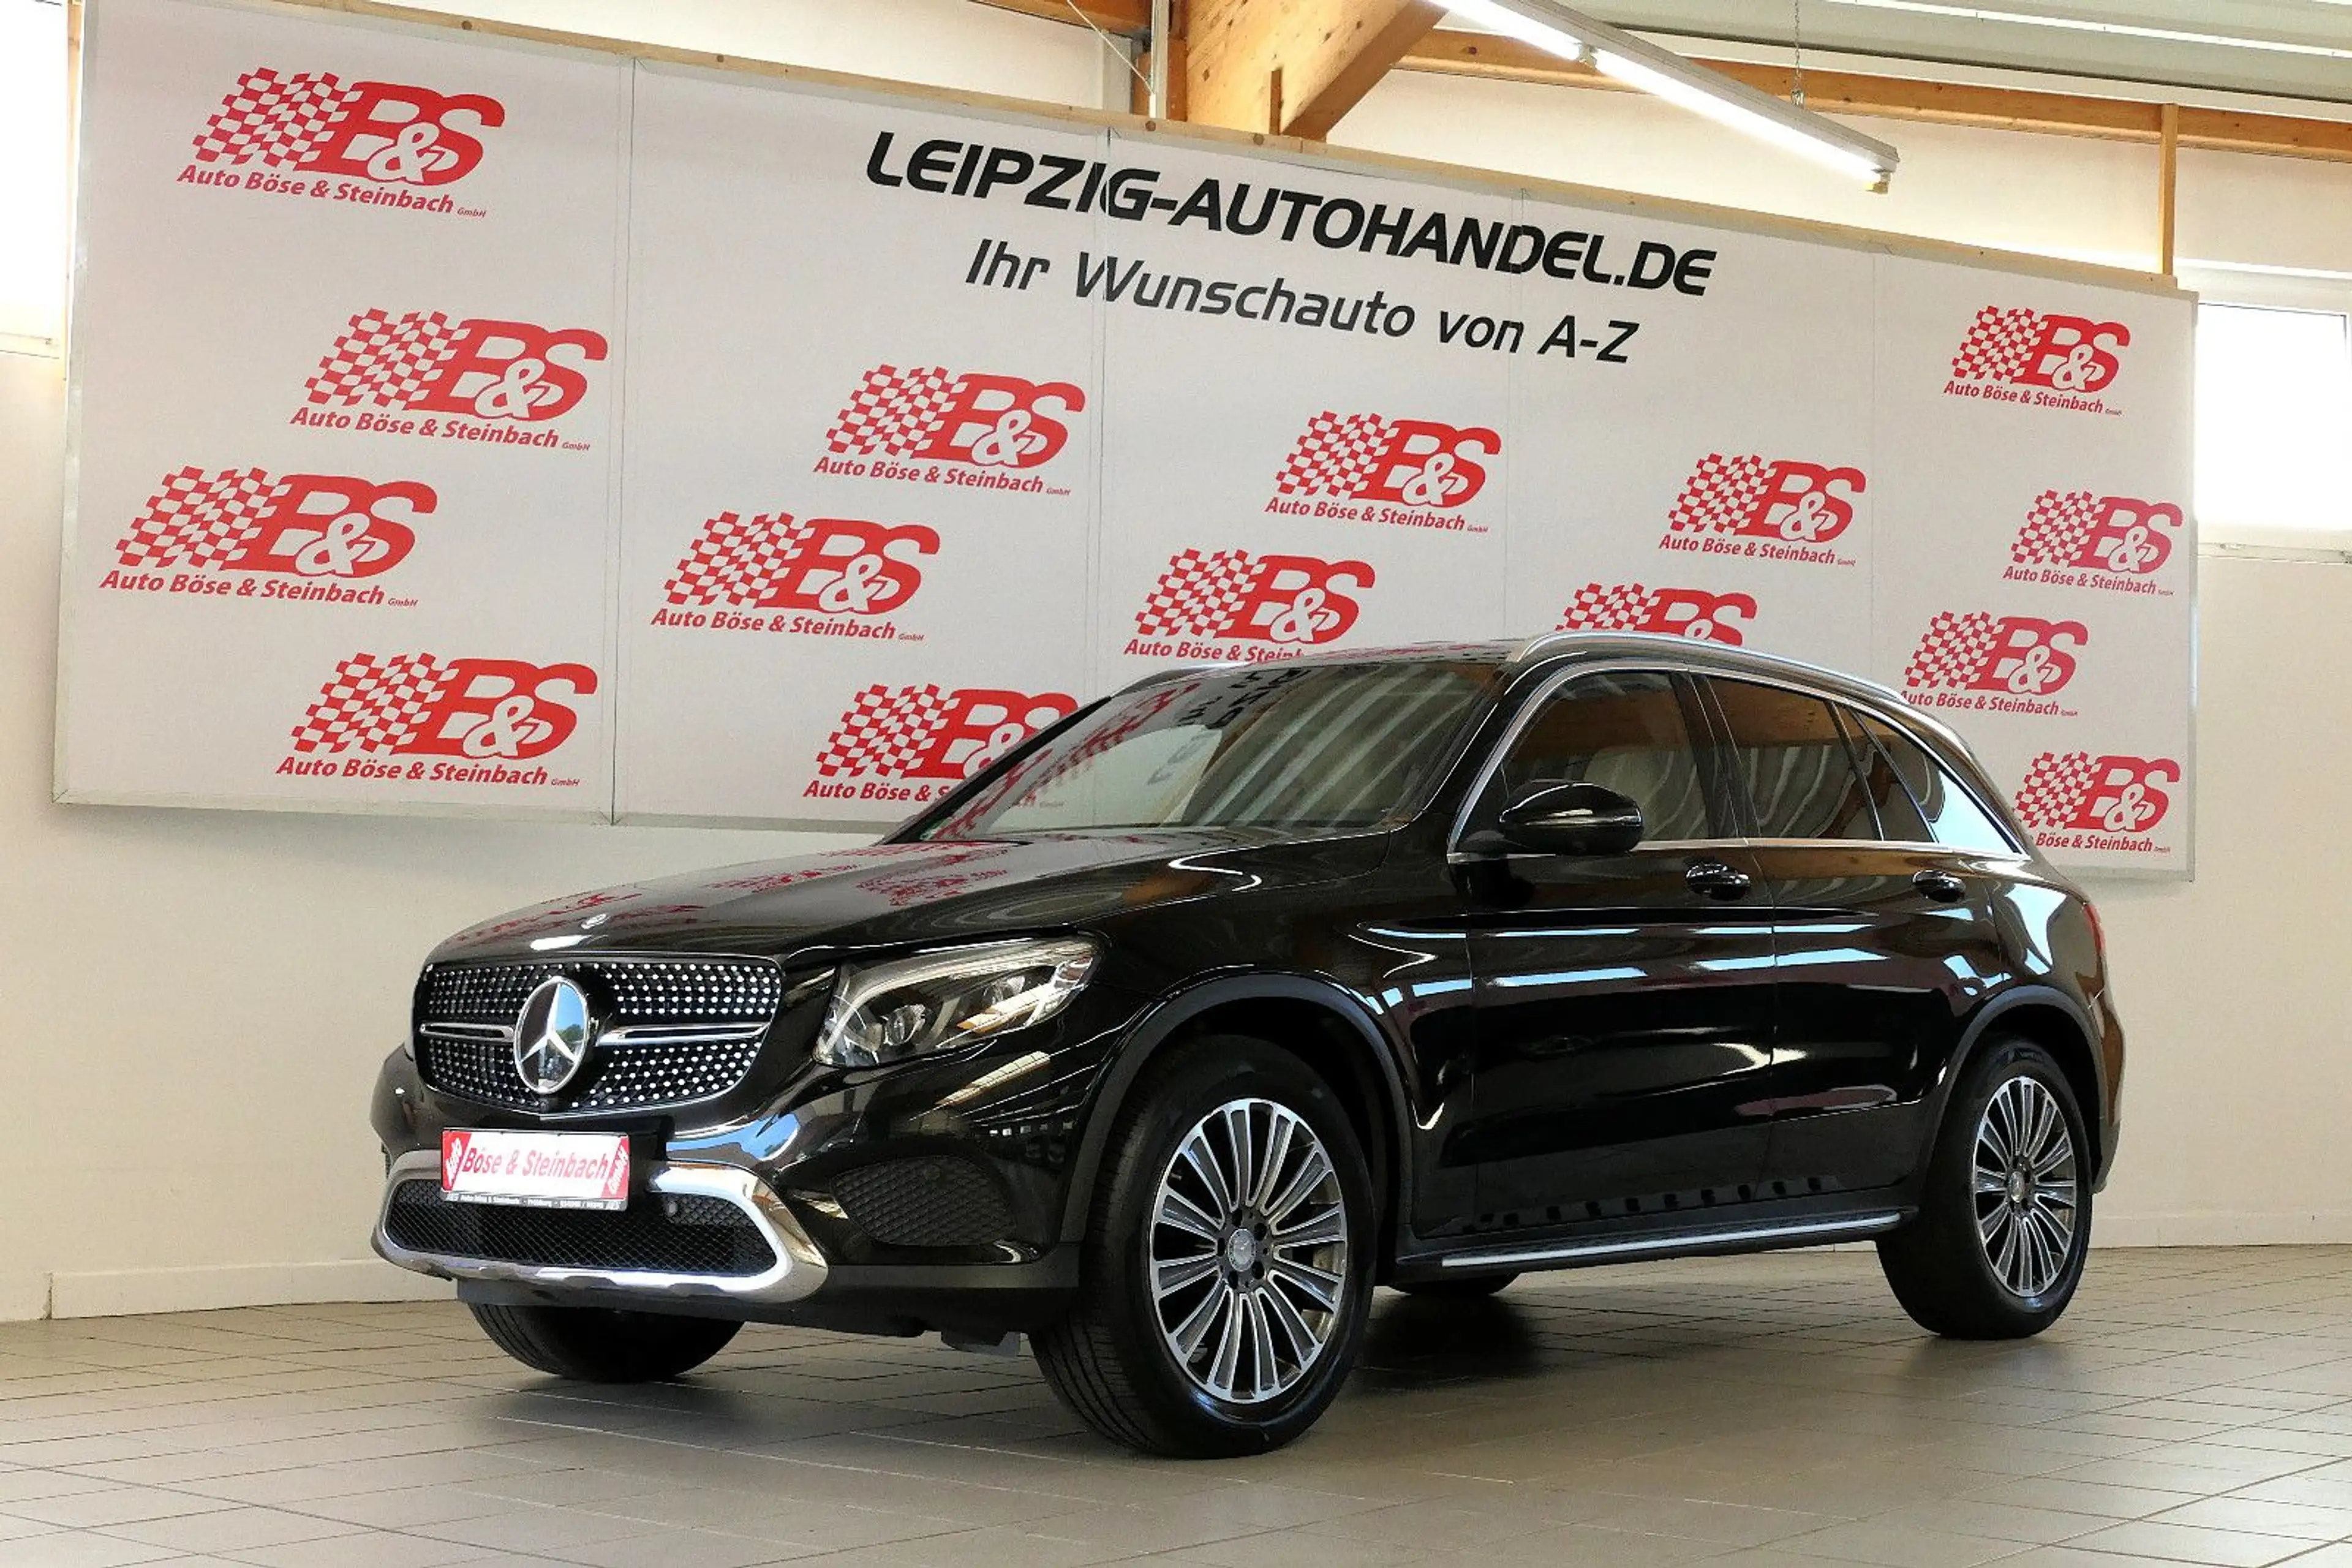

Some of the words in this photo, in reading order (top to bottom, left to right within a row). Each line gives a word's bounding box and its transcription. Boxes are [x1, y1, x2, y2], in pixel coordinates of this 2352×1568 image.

[176, 163, 240, 189] Auto
[244, 171, 306, 196] Böse
[310, 180, 330, 198] &
[333, 182, 454, 213] Steinbach
[457, 207, 486, 218] GmbH
[867, 131, 1717, 296] LEIPZIG-AUTOHANDEL.DE
[965, 239, 1049, 290] Ihr
[1074, 251, 1416, 337] Wunschauto
[1439, 311, 1524, 353] von
[1538, 314, 1638, 363] A-Z
[1943, 380, 1980, 397] Auto
[1983, 385, 2018, 402] Böse
[2020, 390, 2031, 404] &
[2033, 392, 2104, 413] Steinbach
[290, 407, 352, 429] Auto
[355, 411, 415, 435] Böse
[418, 418, 437, 437] &
[442, 419, 559, 448] Steinbach
[562, 441, 590, 451] GmbH
[813, 456, 865, 476] Auto
[870, 460, 920, 483] Böse
[924, 467, 940, 483] &
[944, 468, 1044, 494] Steinbach
[1265, 497, 1311, 515] Auto
[1314, 500, 1357, 519] Böse
[1362, 507, 1374, 523] &
[1379, 508, 1465, 531] Steinbach
[1659, 533, 1698, 551] Auto
[1702, 537, 1741, 555] Böse
[1744, 541, 1756, 557] &
[1760, 543, 1836, 565] Steinbach
[99, 569, 165, 593] Auto
[170, 573, 233, 597] Böse
[236, 578, 256, 598] &
[260, 579, 384, 606] Steinbach
[388, 597, 419, 607] GmbH
[2003, 566, 2038, 582] Auto
[2040, 569, 2075, 586] Böse
[2077, 573, 2088, 587] &
[2090, 575, 2157, 594] Steinbach
[651, 608, 706, 628] Auto
[710, 611, 765, 632] Böse
[768, 615, 785, 633] &
[788, 616, 895, 640] Steinbach
[1125, 639, 1172, 657] Auto
[1176, 641, 1223, 660] Böse
[1226, 644, 1241, 661] &
[1937, 692, 1972, 710] Böse
[1975, 696, 1986, 709] &
[1989, 696, 2059, 715] Steinbach
[275, 755, 339, 777] Auto
[342, 758, 402, 781] Böse
[407, 761, 424, 780] &
[429, 761, 548, 786] Steinbach
[551, 778, 580, 787] GmbH
[803, 779, 856, 799] Auto
[860, 781, 911, 802] Böse
[914, 785, 930, 802] &
[2036, 833, 2069, 848] Böse
[2071, 835, 2083, 848] &
[2085, 835, 2153, 852] Steinbach
[462, 1147, 501, 1174] Böse
[506, 1150, 519, 1175] &
[522, 1150, 608, 1180] Steinbach
